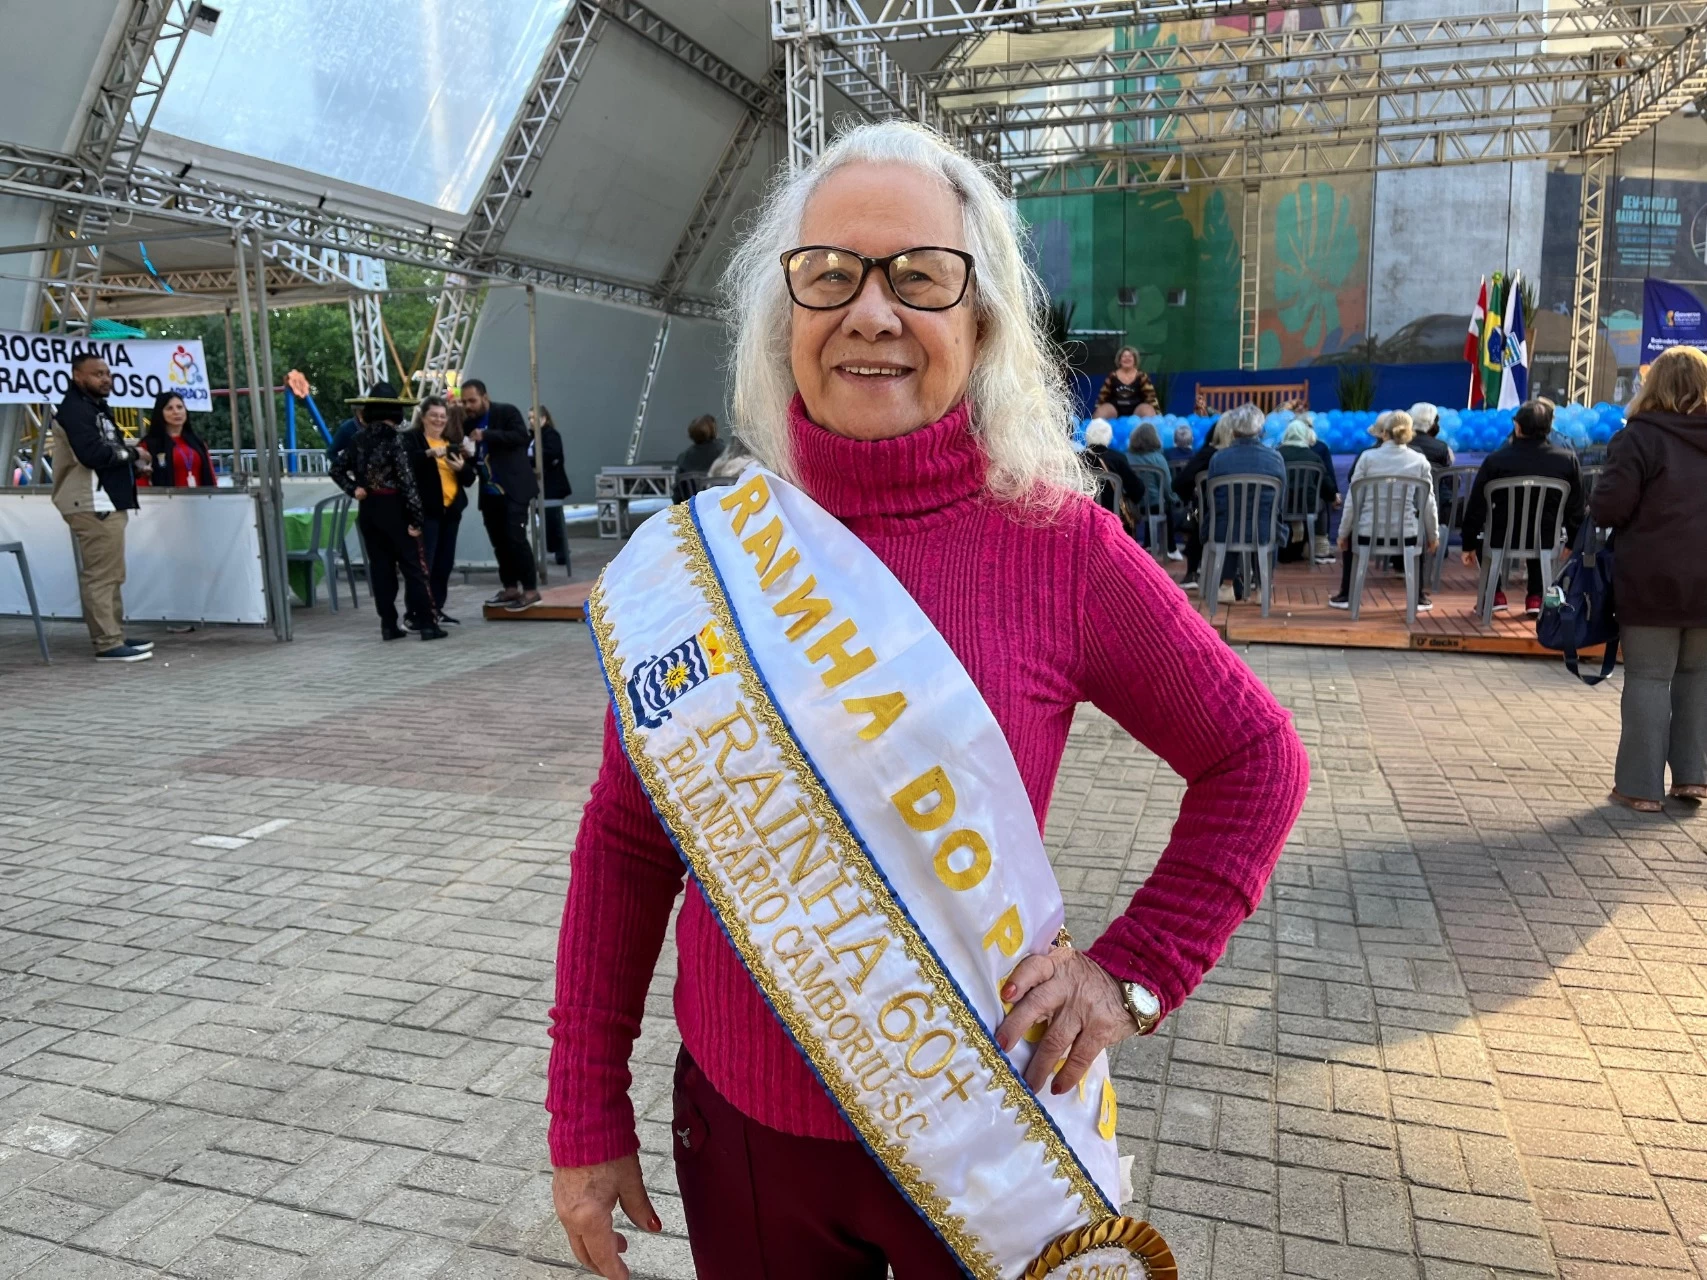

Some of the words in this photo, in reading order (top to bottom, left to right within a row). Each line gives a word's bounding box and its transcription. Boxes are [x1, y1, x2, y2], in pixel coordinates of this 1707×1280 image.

[695, 700, 890, 996] RAINHA
[877, 990, 975, 1102] 60+
[891, 765, 992, 892] DO
